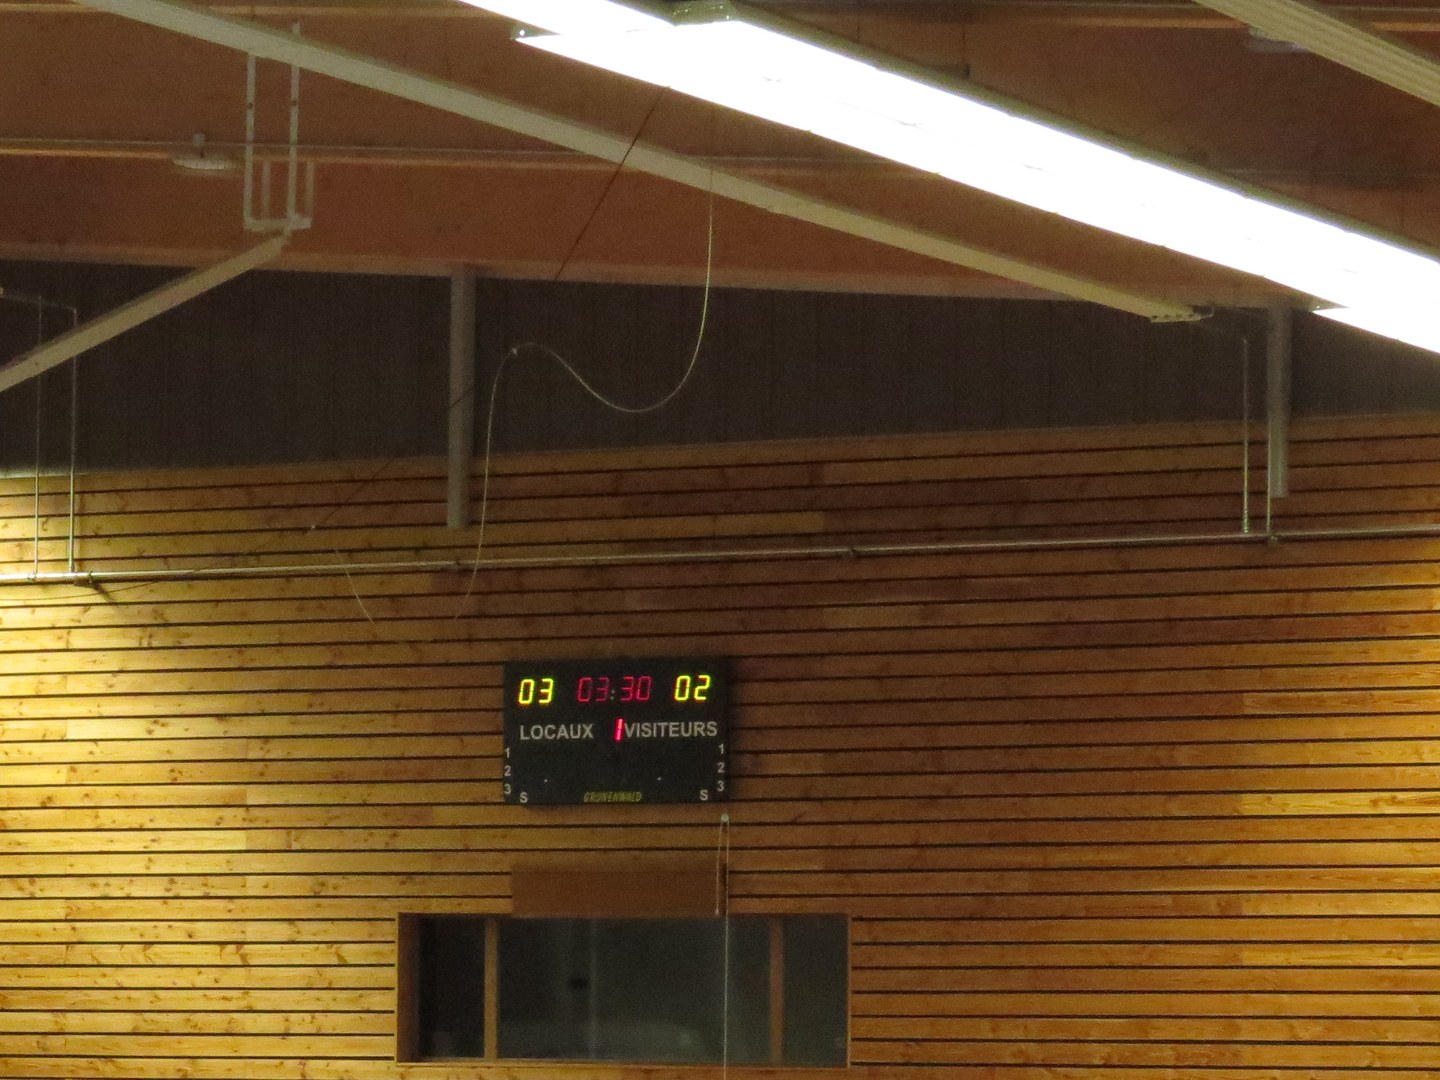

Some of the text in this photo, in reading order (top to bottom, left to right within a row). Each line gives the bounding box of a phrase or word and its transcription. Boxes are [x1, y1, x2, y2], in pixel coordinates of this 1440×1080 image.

[518, 678, 554, 705] 03
[577, 676, 652, 702] 03:30
[674, 674, 711, 701] 02
[520, 724, 594, 740] LOCAUX
[624, 721, 718, 738] VISITEURS
[505, 748, 510, 758] 1
[719, 744, 724, 754] 1
[504, 766, 511, 776] 2
[718, 762, 724, 773] 2
[504, 784, 511, 794] 3
[717, 781, 724, 791] 3
[520, 792, 528, 803] S
[700, 790, 708, 801] S
